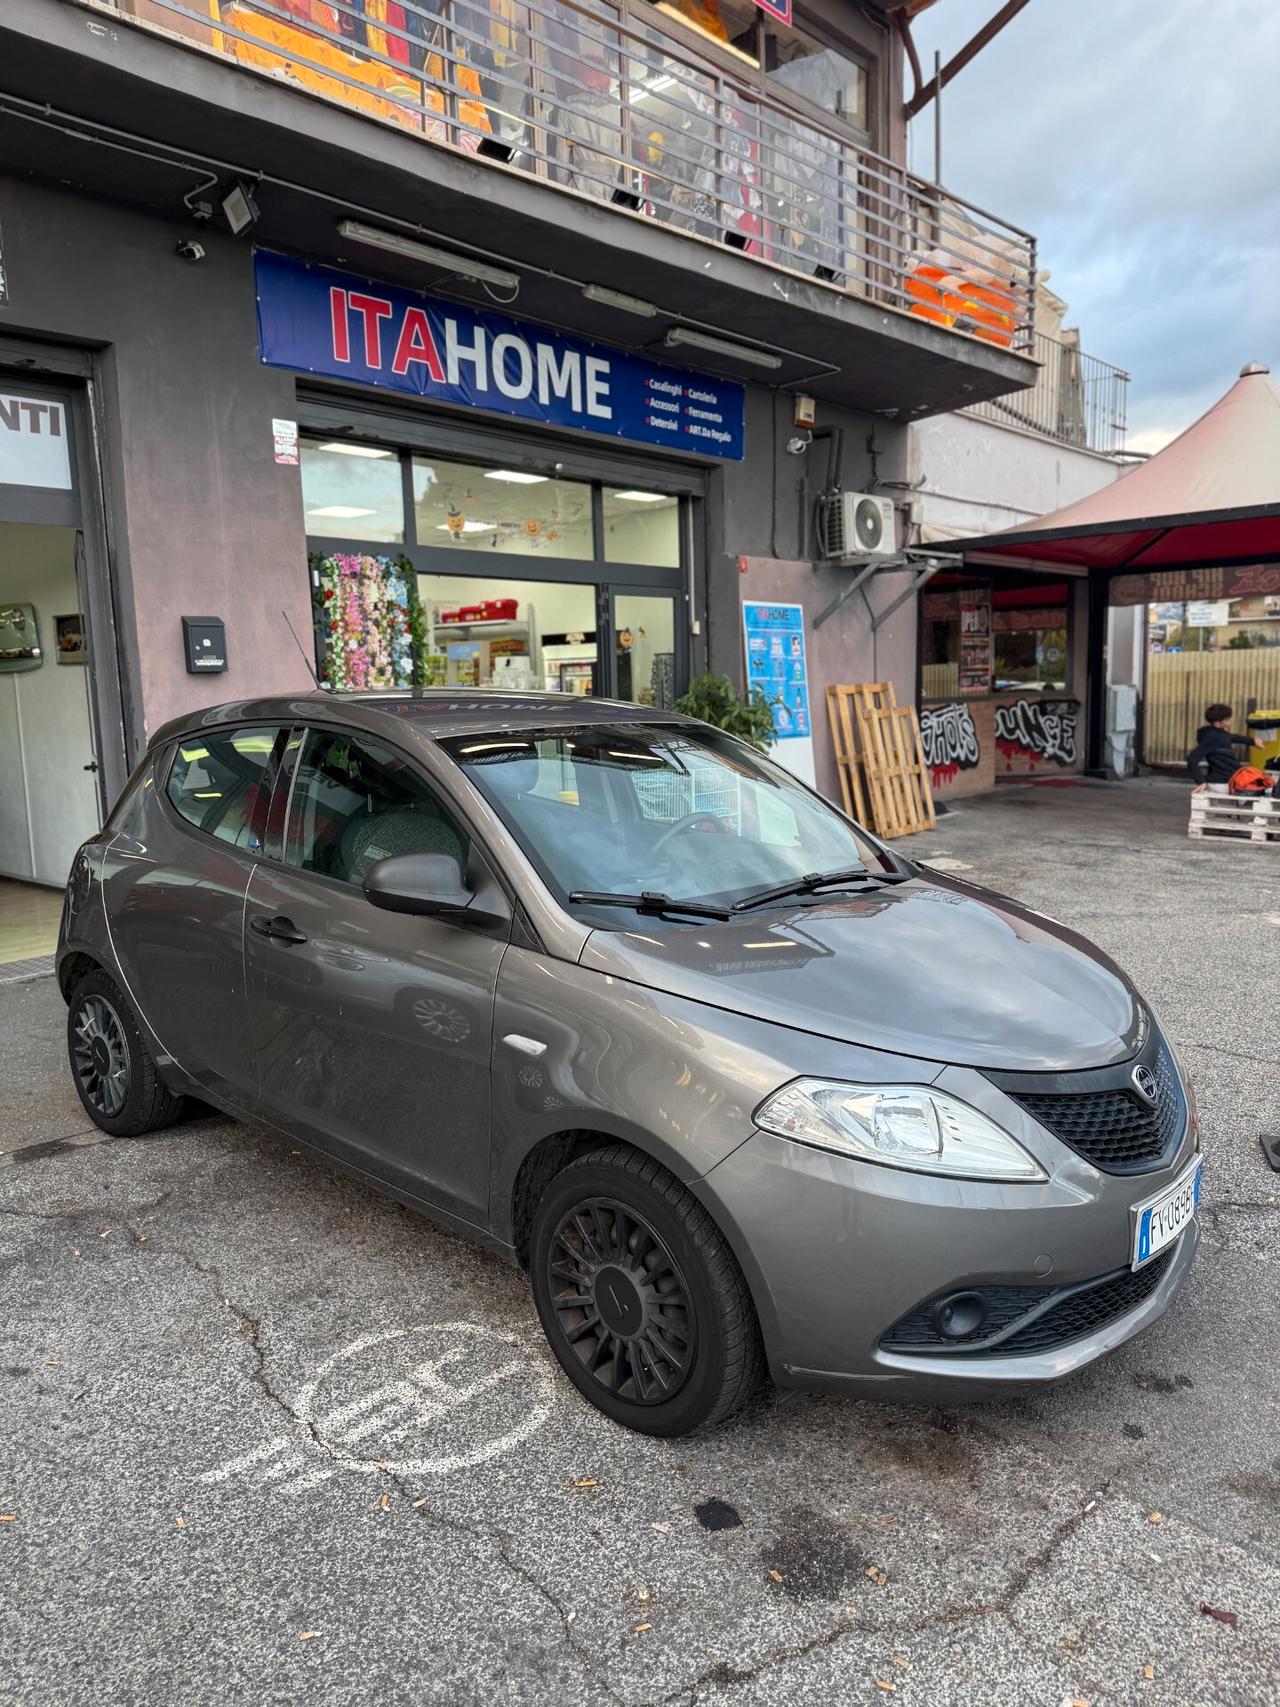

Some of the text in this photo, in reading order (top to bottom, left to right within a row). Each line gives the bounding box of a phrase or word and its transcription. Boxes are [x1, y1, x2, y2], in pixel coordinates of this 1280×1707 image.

[330, 286, 613, 420] ITAHOME
[649, 379, 683, 397] Casalinghi
[688, 388, 718, 405] Cartoleria
[649, 397, 680, 414] Accessori
[649, 415, 678, 432] Detersivi
[688, 406, 723, 424] Ferramenta
